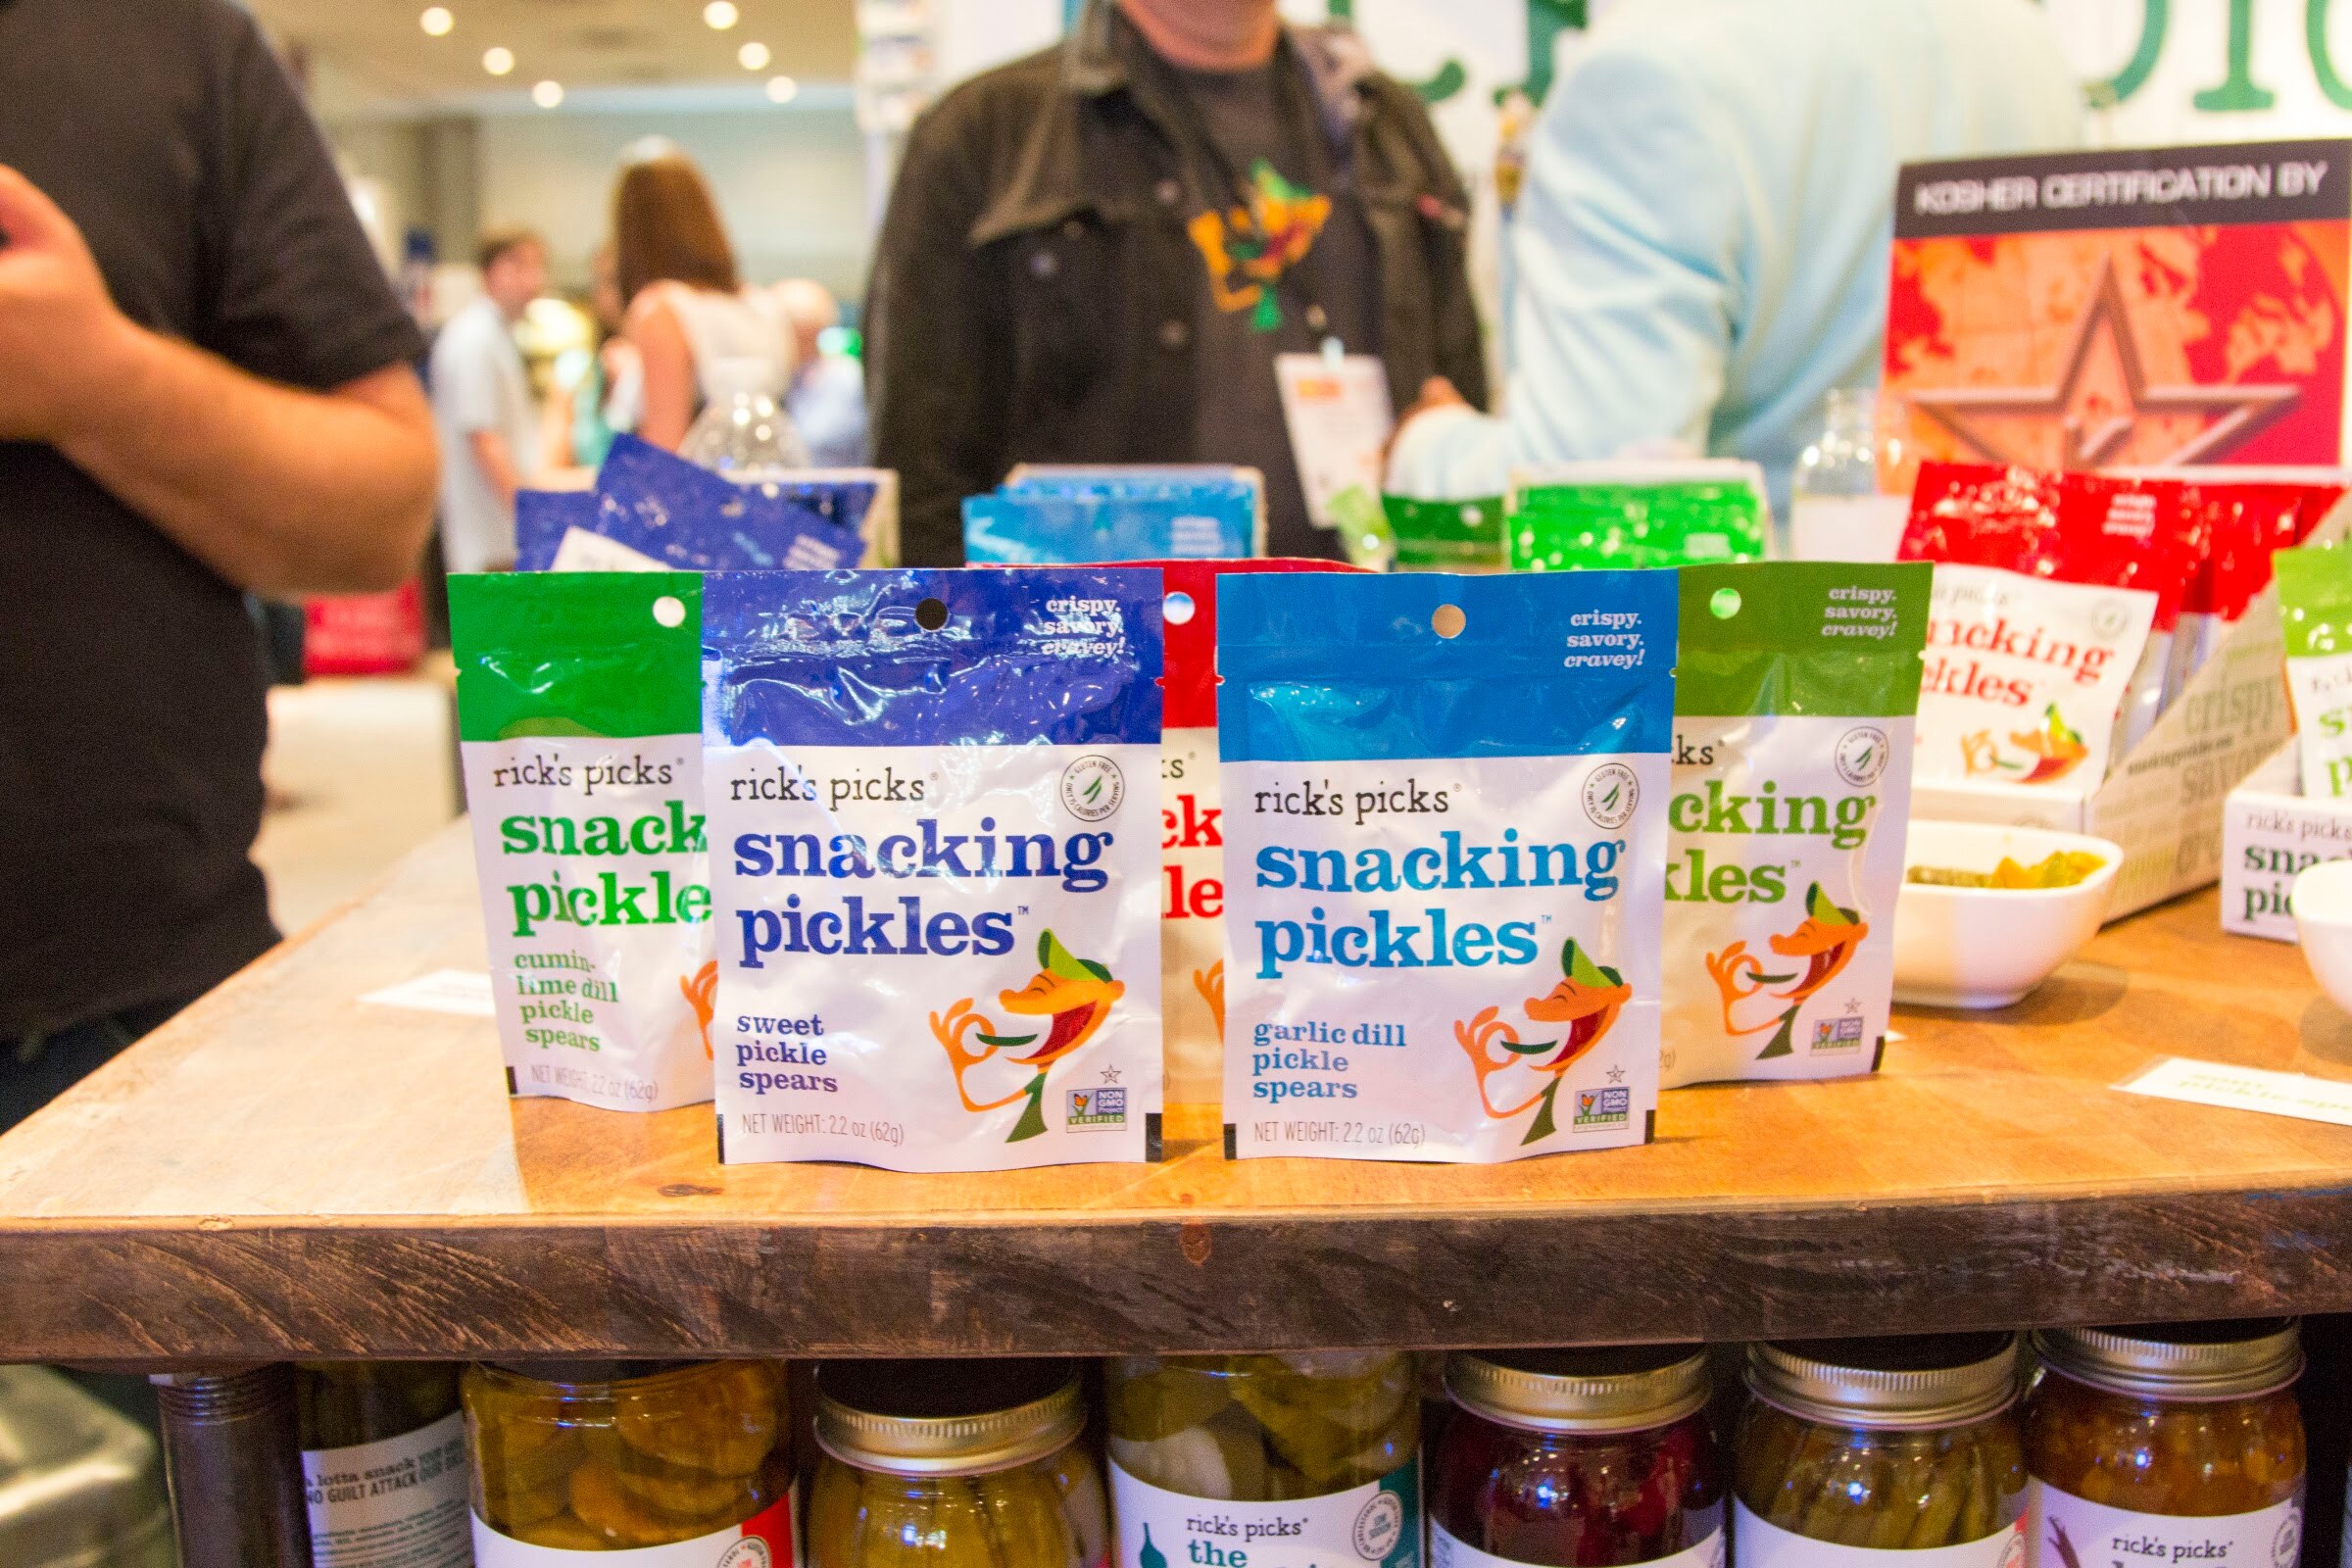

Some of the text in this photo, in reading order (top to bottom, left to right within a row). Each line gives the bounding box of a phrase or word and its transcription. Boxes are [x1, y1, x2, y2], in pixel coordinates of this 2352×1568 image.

[1914, 160, 2329, 215] KOSHER CERTIFICATION BY
[1046, 596, 1121, 617] crispy.
[1829, 585, 1897, 605] crispy.
[1570, 609, 1642, 630] crispy.
[1825, 608, 1897, 622] savory.
[1566, 633, 1645, 651] savory.
[1563, 649, 1646, 670] cravey!
[1672, 735, 1715, 765] ks
[730, 765, 817, 802] rick's
[1254, 778, 1344, 816] rick's
[734, 816, 1114, 893] snacking
[1255, 827, 1627, 902] snacking
[515, 975, 619, 1003] lime dill
[519, 1000, 594, 1025] pickle
[736, 1013, 825, 1036] sweet
[524, 1028, 601, 1054] spears
[1253, 1021, 1407, 1047] garlic dill
[735, 1040, 828, 1067] pickle
[1252, 1047, 1349, 1076] pickle
[739, 1071, 839, 1095] spears
[1253, 1080, 1358, 1103] spears
[742, 1113, 766, 1134] NET
[852, 1121, 866, 1138] oz
[870, 1121, 905, 1147] (62g)
[1253, 1121, 1280, 1142] NET
[1367, 1127, 1384, 1144] oz
[1389, 1123, 1426, 1149] (62g)
[1186, 1515, 1239, 1537] rick's
[1188, 1538, 1248, 1568] the
[2112, 1536, 2167, 1558] rick's
